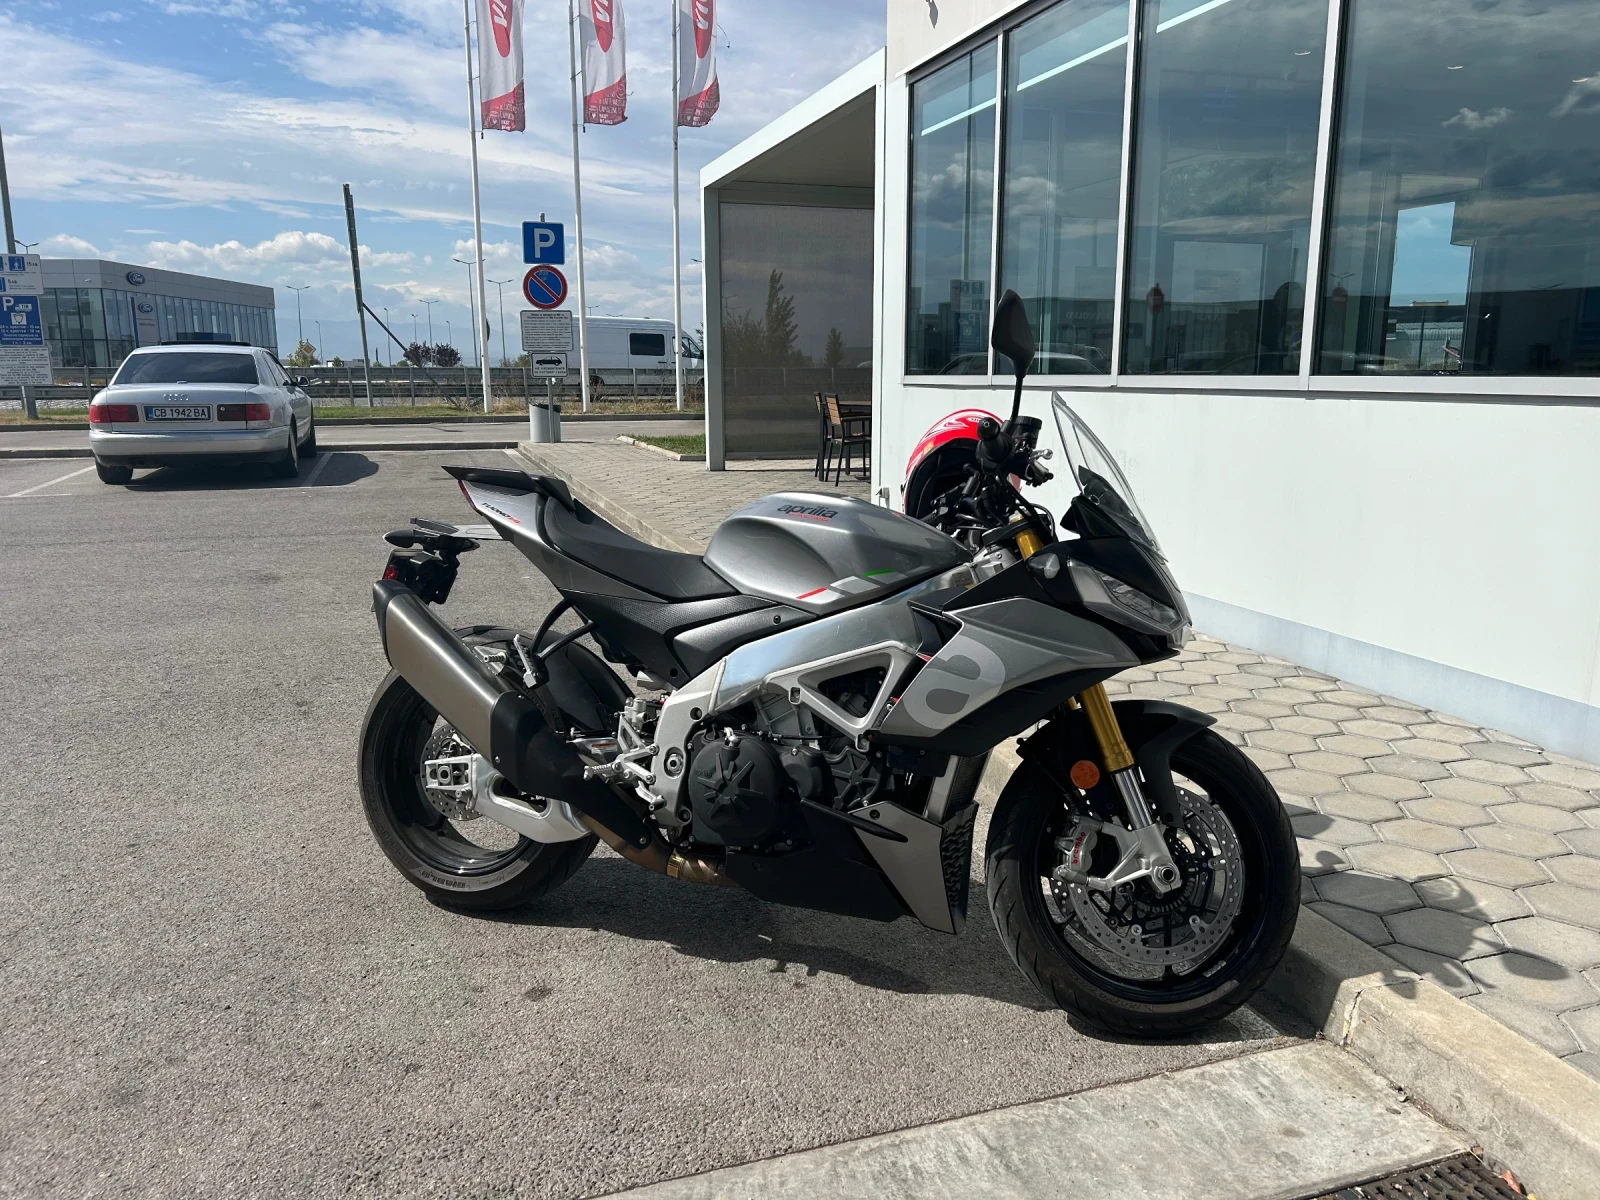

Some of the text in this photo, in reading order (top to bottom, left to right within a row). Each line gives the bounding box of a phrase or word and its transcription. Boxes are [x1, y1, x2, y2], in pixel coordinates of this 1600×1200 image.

[534, 228, 556, 259] P
[2, 296, 15, 311] P
[154, 408, 207, 418] CB 1942 BA
[776, 504, 838, 519] aprilia
[1071, 831, 1086, 865] brembo
